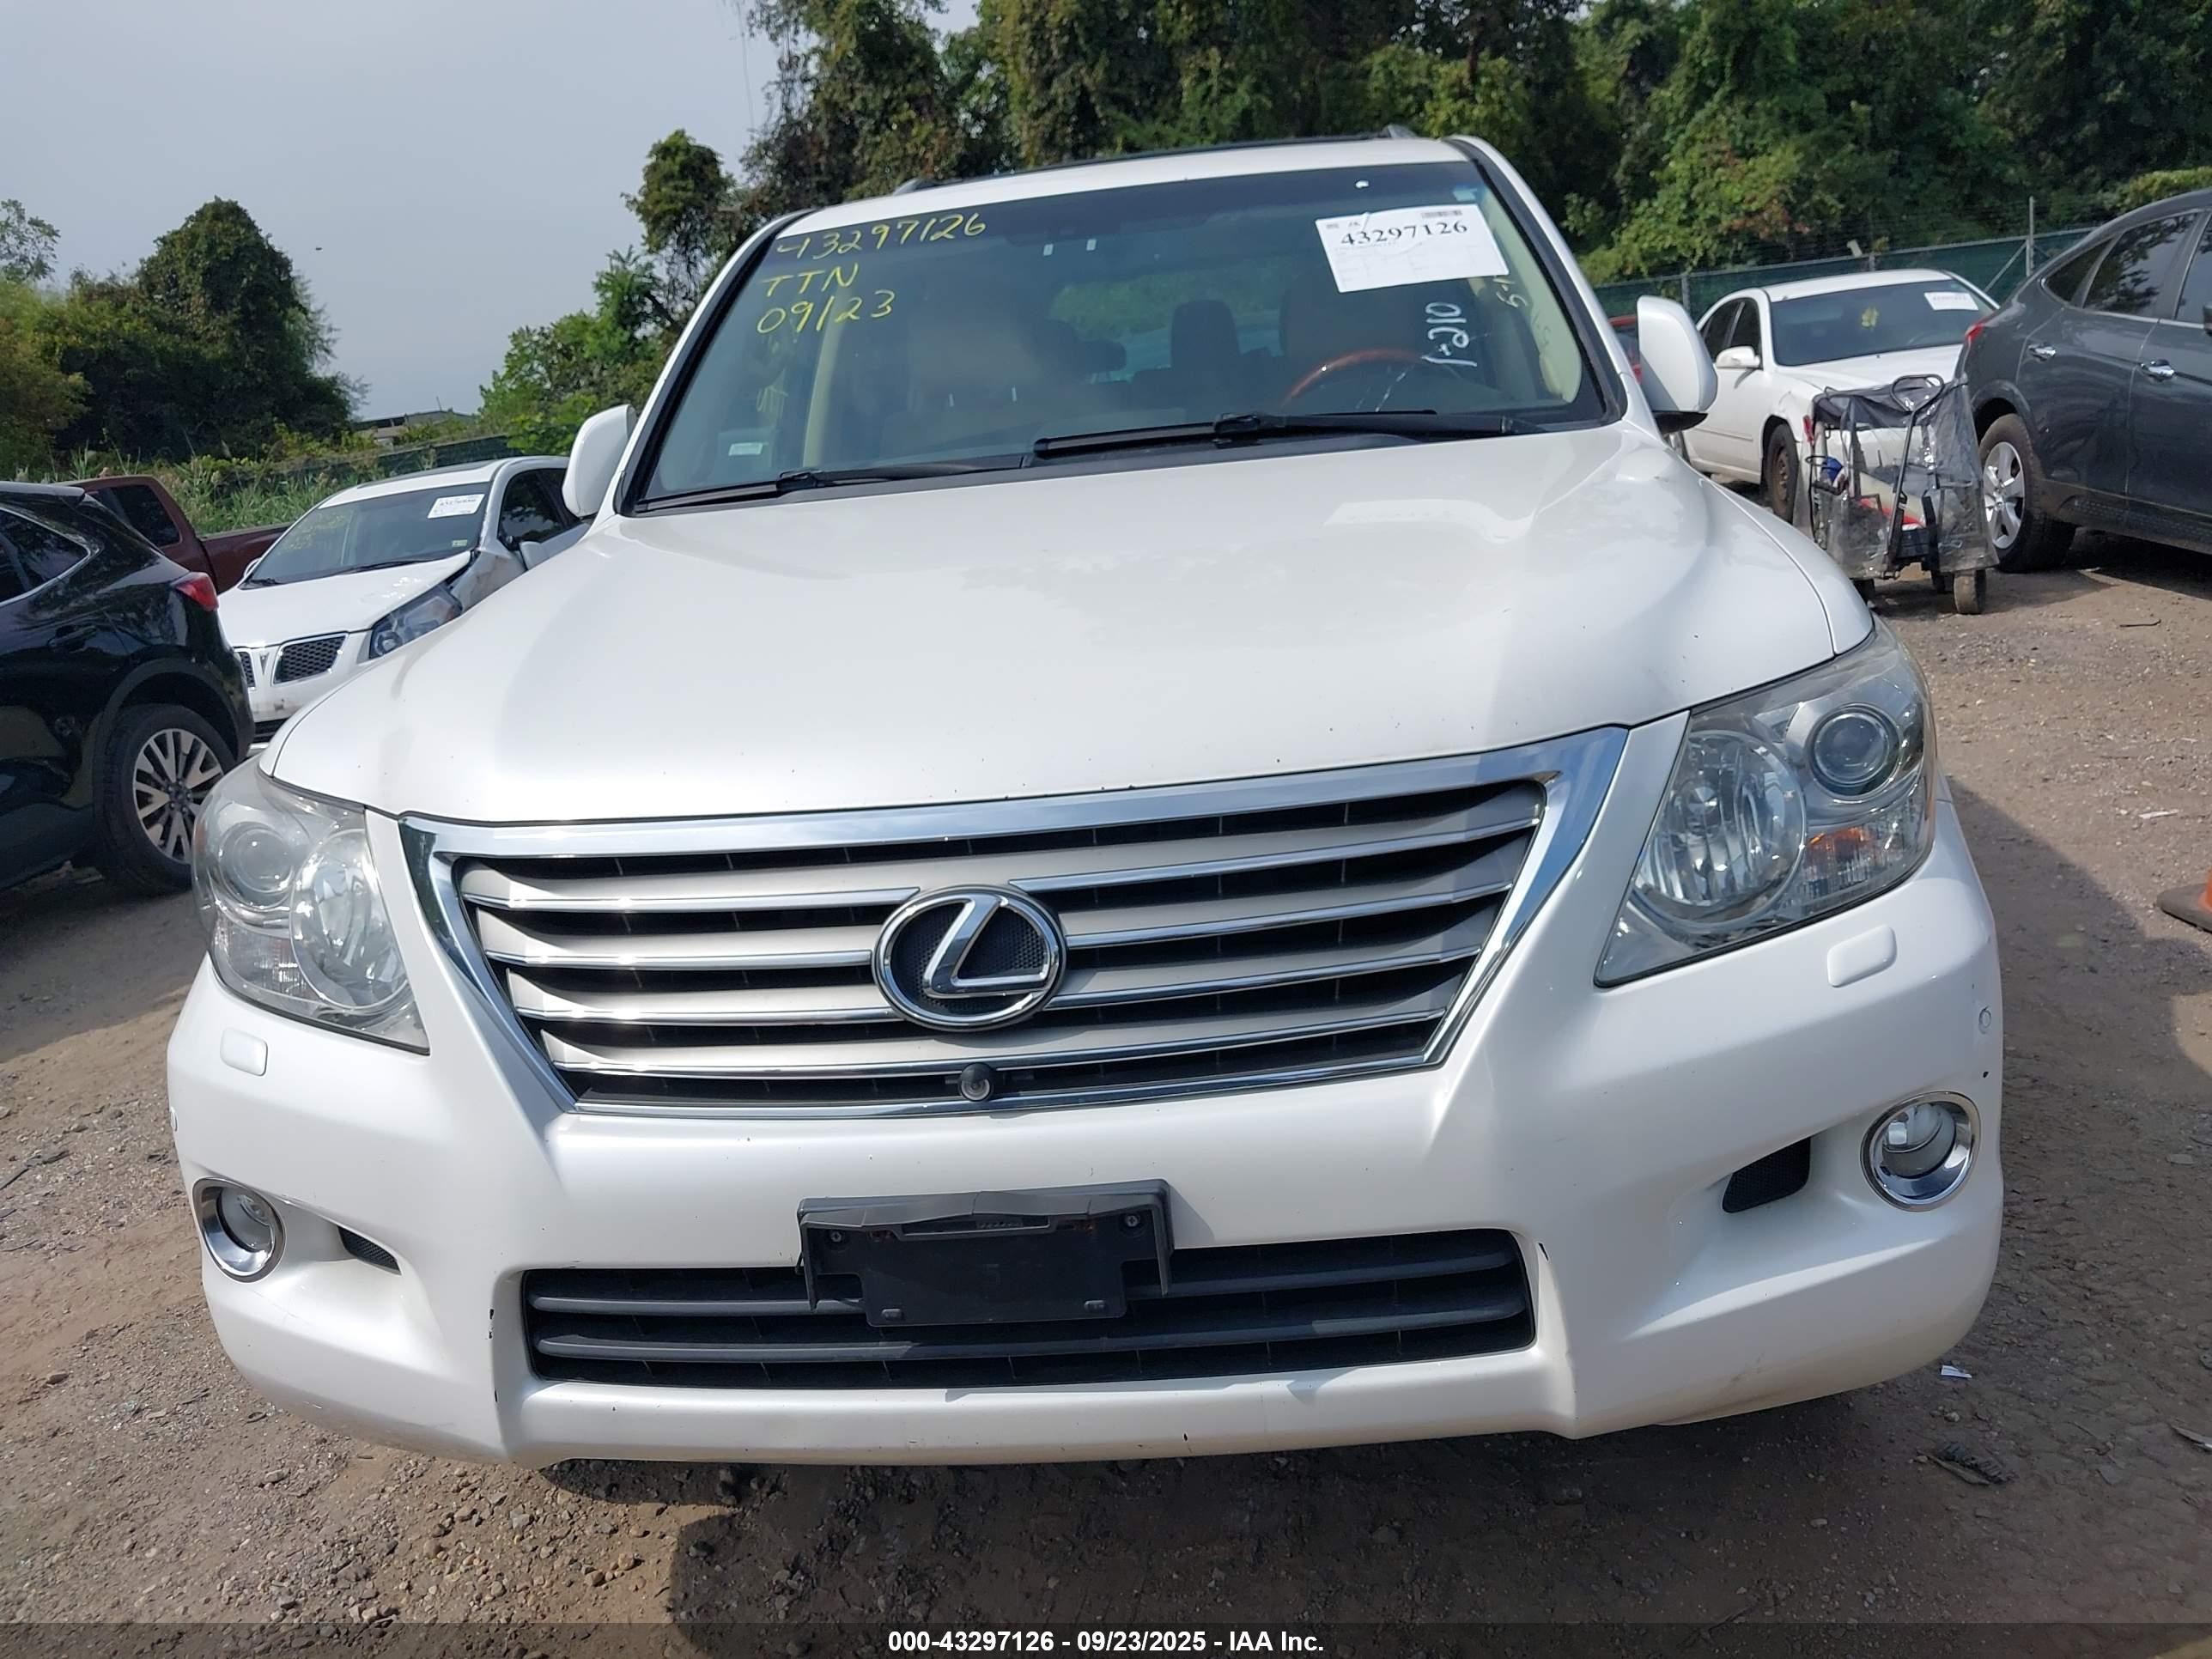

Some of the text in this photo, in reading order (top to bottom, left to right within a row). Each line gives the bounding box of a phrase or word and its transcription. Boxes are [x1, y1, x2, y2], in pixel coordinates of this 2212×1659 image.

[776, 212, 987, 260] 43297126
[1340, 220, 1468, 246] 43297126
[763, 262, 859, 298] TTN
[757, 289, 896, 335] 09/23
